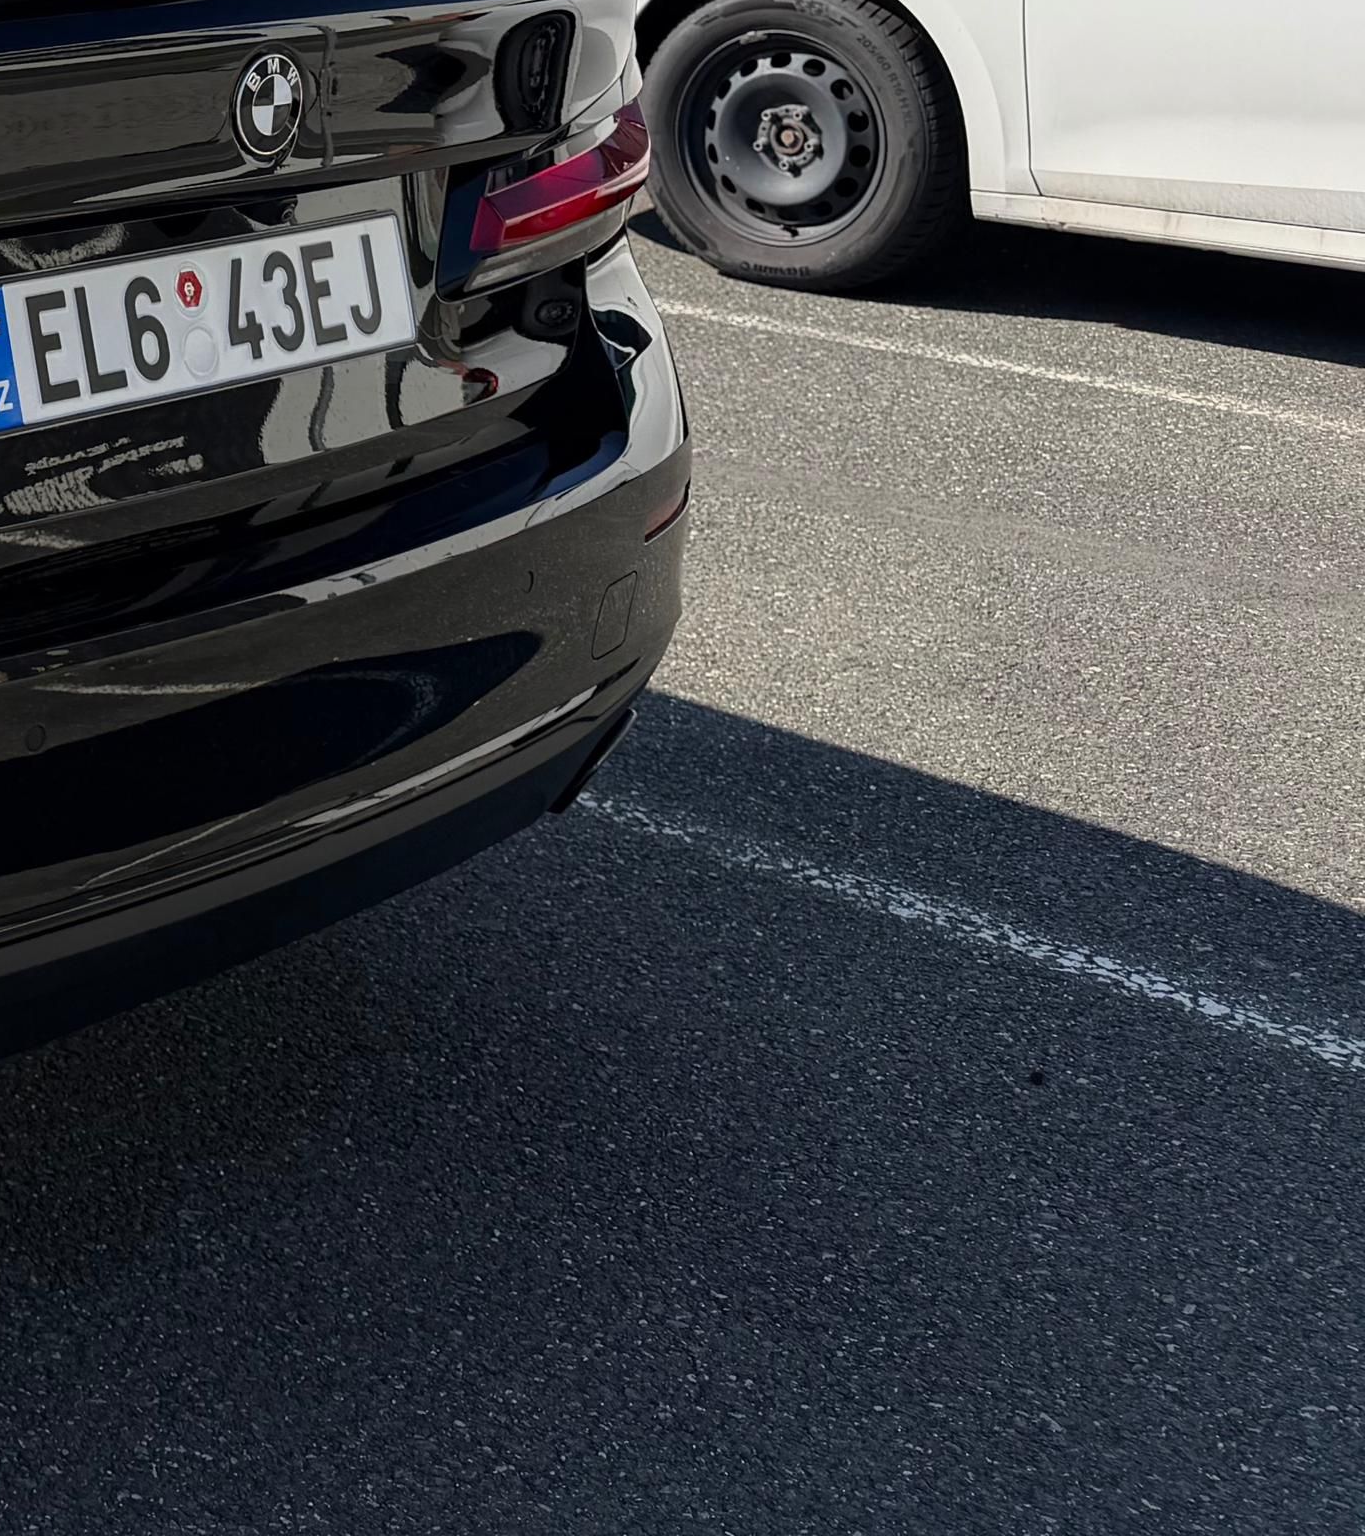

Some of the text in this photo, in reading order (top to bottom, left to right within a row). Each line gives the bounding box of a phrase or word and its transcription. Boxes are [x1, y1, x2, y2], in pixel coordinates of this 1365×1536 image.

[246, 57, 298, 92] BMW
[25, 234, 383, 405] EL6 43EJ
